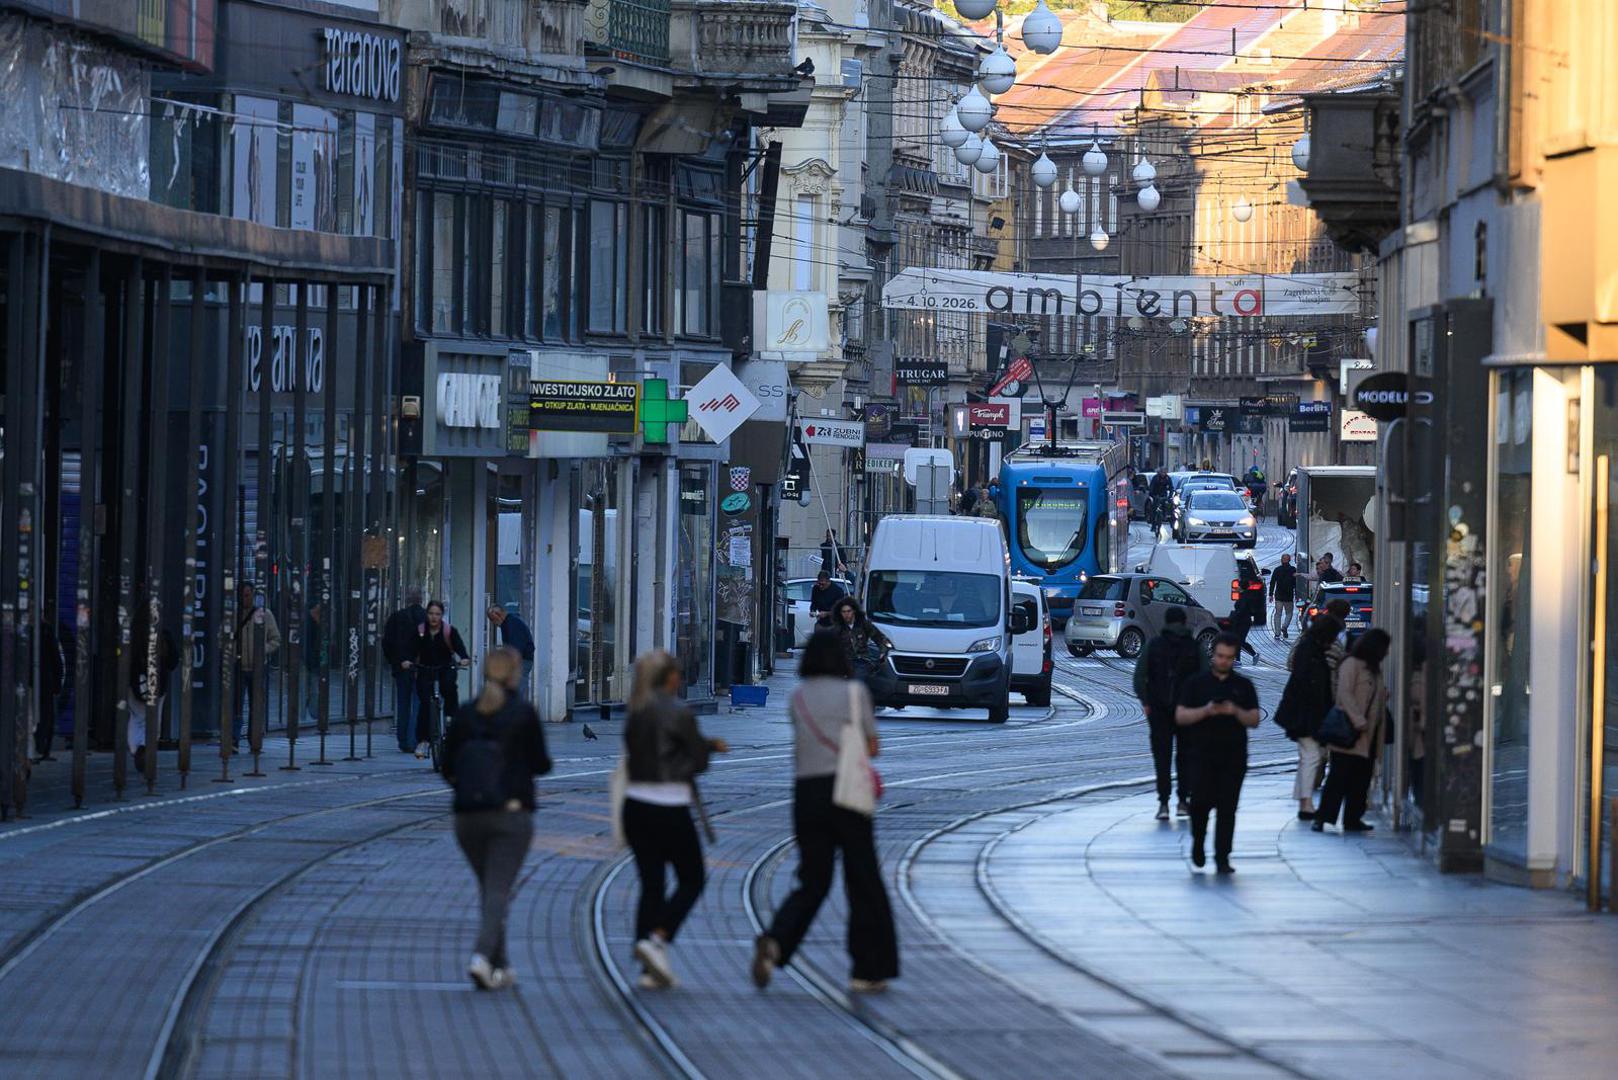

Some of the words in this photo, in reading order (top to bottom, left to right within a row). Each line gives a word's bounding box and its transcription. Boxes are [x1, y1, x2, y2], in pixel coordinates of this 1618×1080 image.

[985, 273, 1262, 317] ambienta
[887, 296, 895, 306] 1.
[908, 297, 918, 307] 4.
[922, 297, 938, 308] 10.
[941, 298, 979, 309] 2026.
[603, 386, 636, 399] ZLATO
[545, 402, 566, 411] OTKUP
[567, 403, 584, 412] ZLATA
[971, 407, 1006, 421] Triumph
